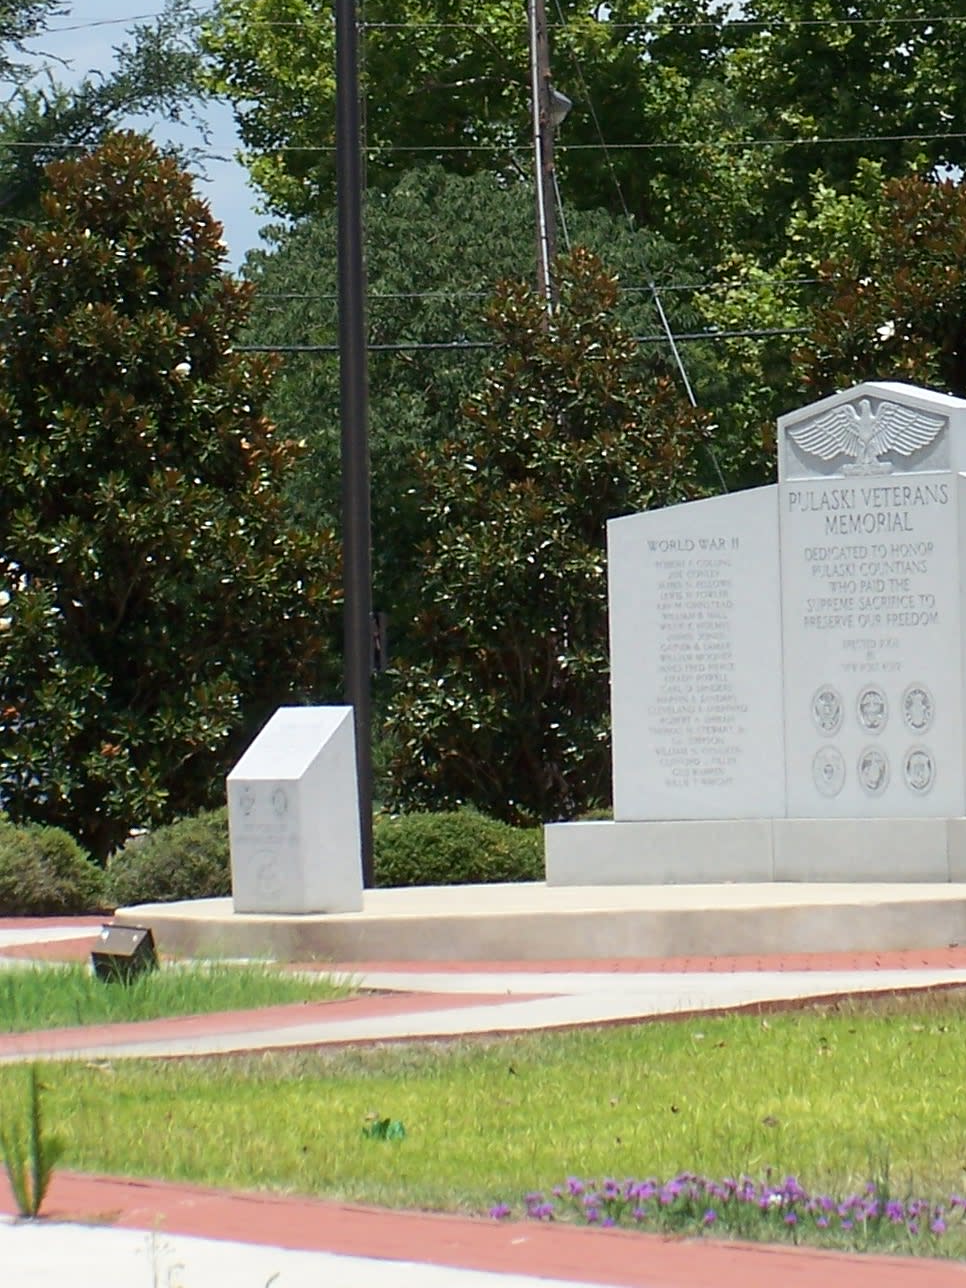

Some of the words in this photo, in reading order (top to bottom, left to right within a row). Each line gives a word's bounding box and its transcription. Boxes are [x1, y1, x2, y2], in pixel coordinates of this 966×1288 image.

[788, 488, 856, 513] PULASKI
[860, 484, 949, 509] VETERANS
[825, 511, 914, 536] MEMORIAL
[647, 539, 695, 553] WORLD
[699, 537, 726, 551] WAR
[731, 536, 740, 551] II
[803, 545, 868, 562] DEDICATED
[870, 543, 887, 560] TO
[890, 541, 935, 558] HONOR
[811, 562, 856, 578] PULASKI
[828, 579, 857, 594] WHO
[859, 578, 886, 593] PAID
[888, 577, 911, 592] THE
[806, 596, 855, 613] SUPREME
[858, 594, 915, 611] SACRIFICE
[917, 593, 936, 609] TO
[857, 613, 881, 629] OUR
